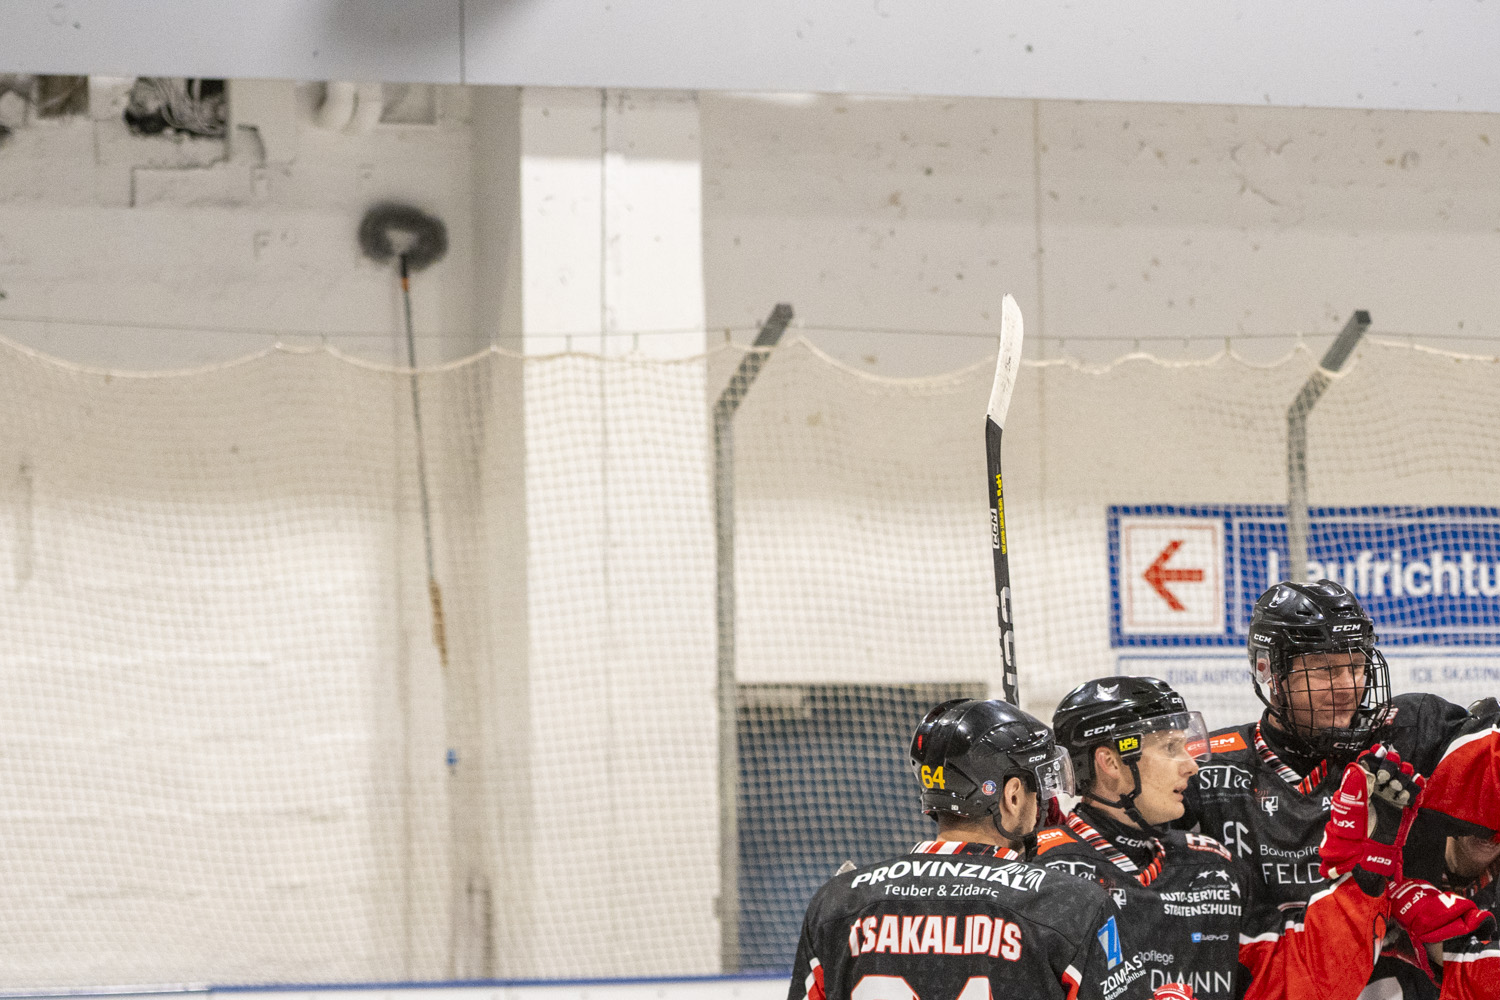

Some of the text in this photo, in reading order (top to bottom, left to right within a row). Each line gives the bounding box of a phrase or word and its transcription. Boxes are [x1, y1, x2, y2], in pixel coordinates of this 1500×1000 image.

[1332, 624, 1362, 633] CCM
[1253, 633, 1273, 644] CCM
[1083, 723, 1117, 739] CCM
[1028, 753, 1047, 763] CCM
[920, 765, 946, 790] 64
[1366, 855, 1392, 866] CCM
[851, 860, 1029, 892] PROVINZIAL
[1262, 863, 1325, 885] FELD
[884, 884, 999, 898] Teuber & Zidaric
[848, 914, 1023, 963] TSAKALIDIS
